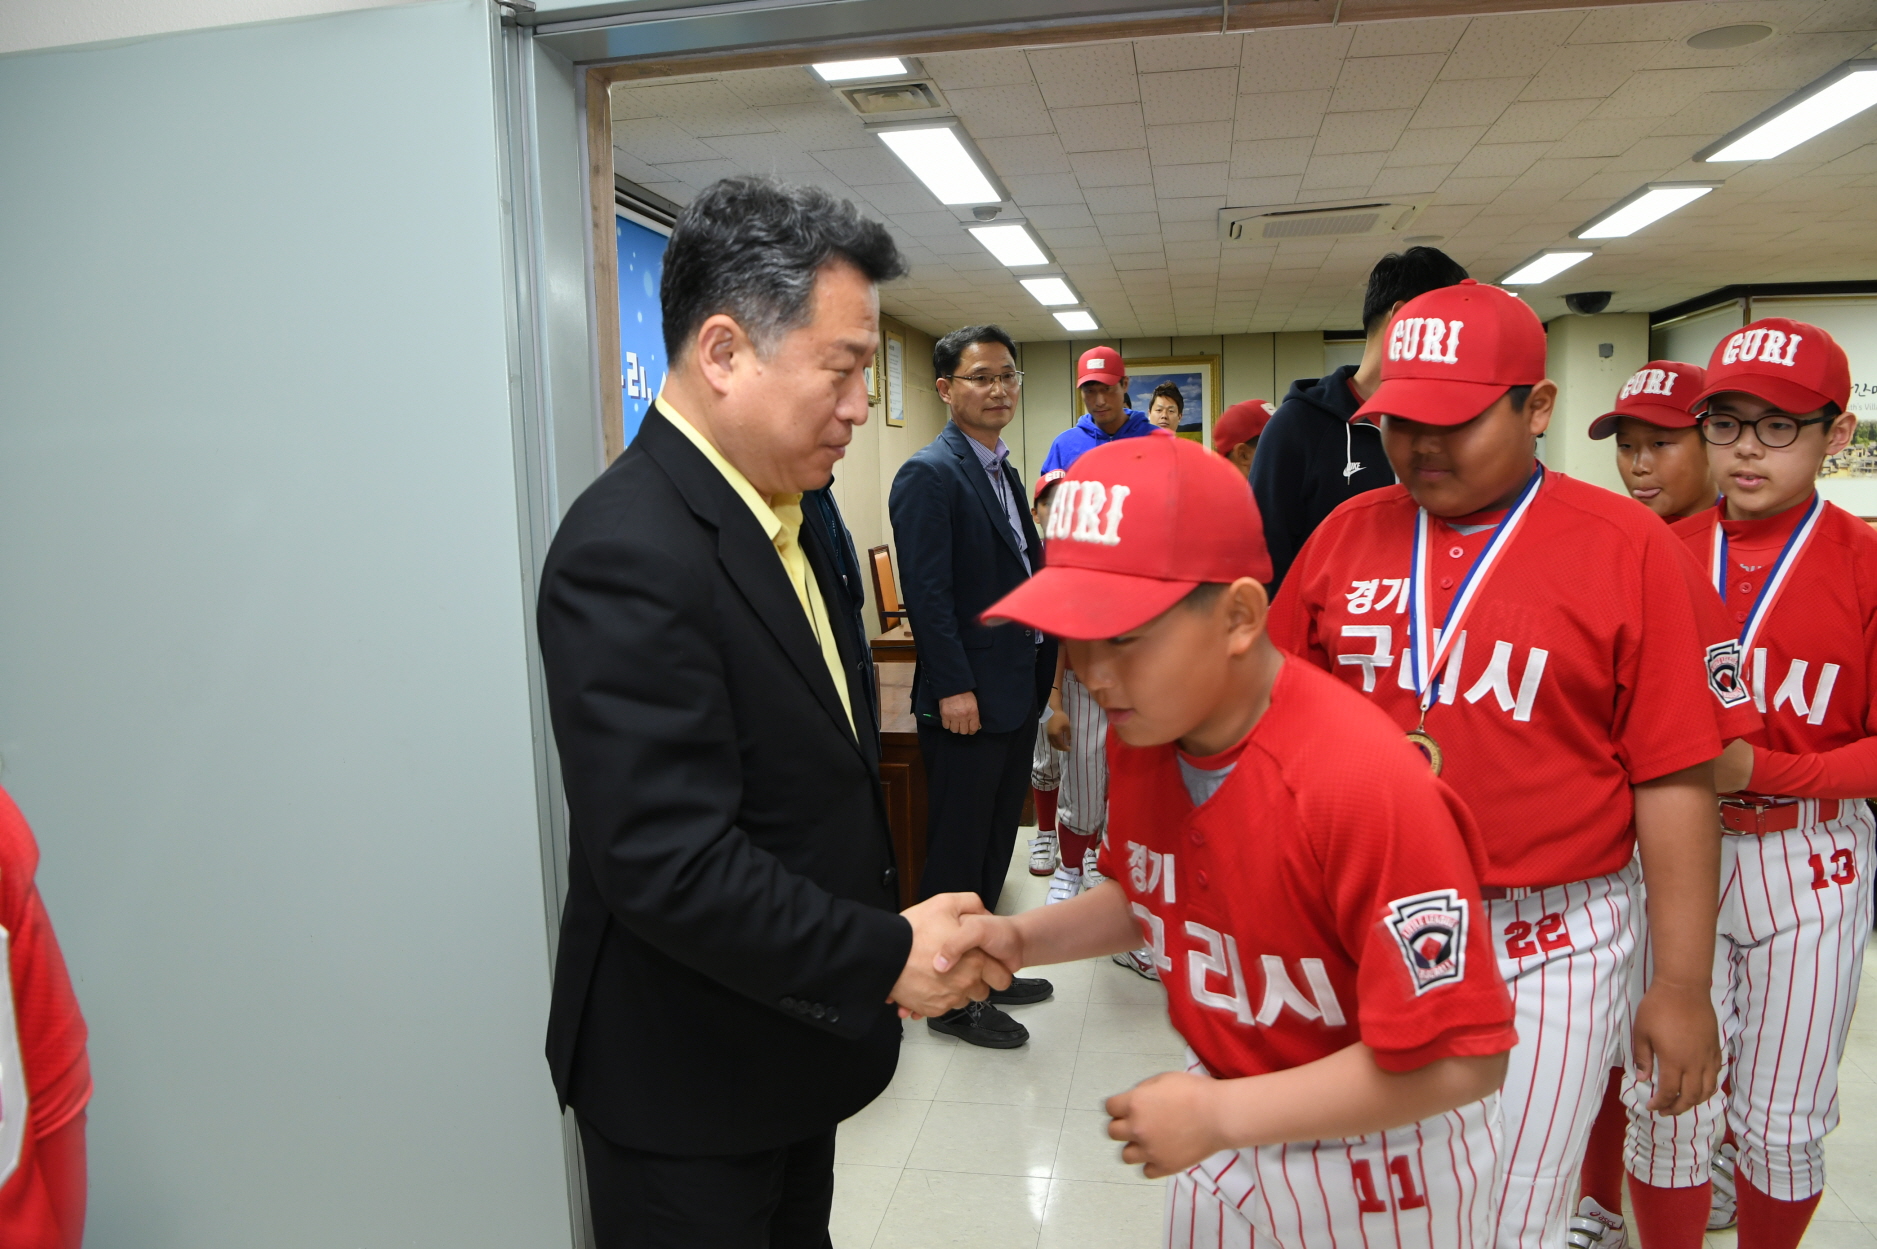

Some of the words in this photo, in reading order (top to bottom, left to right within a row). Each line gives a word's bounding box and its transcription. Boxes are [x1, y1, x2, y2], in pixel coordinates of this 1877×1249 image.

[1388, 317, 1464, 365] GURI
[1722, 328, 1802, 367] GURI
[1619, 368, 1679, 400] GURI
[1345, 578, 1410, 614] 경기
[1126, 840, 1176, 903] 경기
[1808, 848, 1856, 890] 13
[1504, 912, 1569, 959] 22
[1352, 1154, 1426, 1213] 11
